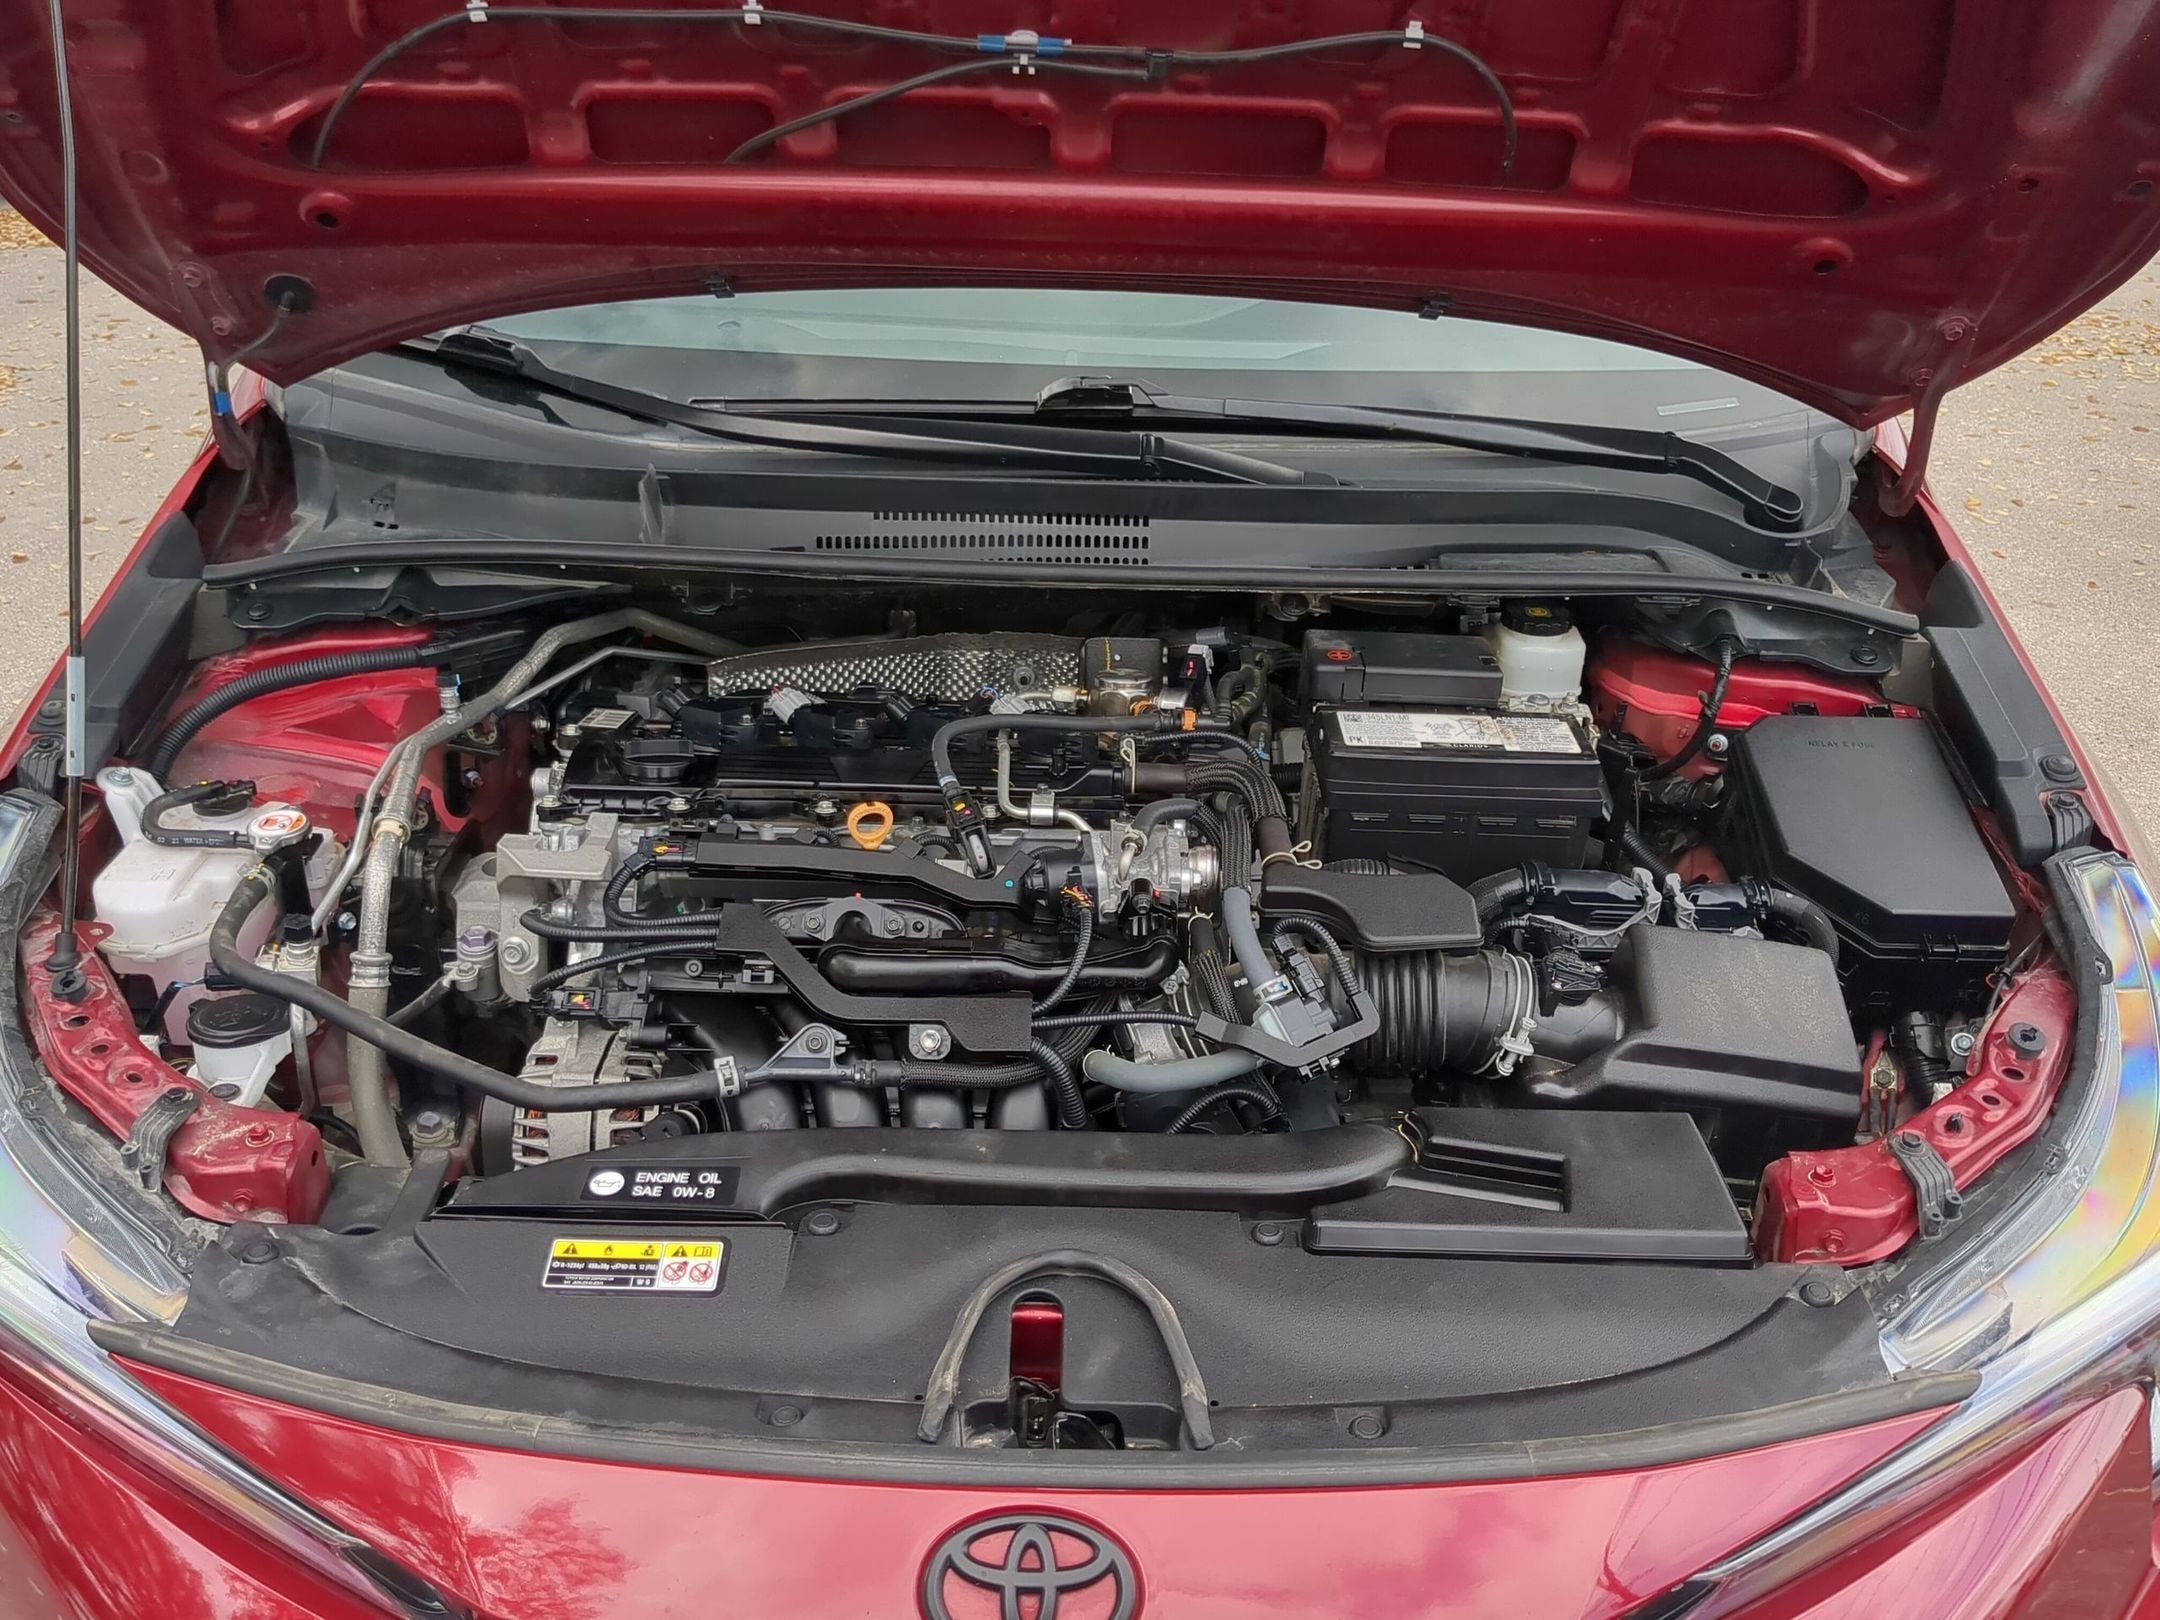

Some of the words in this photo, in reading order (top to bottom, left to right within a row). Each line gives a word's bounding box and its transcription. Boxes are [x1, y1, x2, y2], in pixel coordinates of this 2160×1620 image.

[635, 1172, 690, 1184] ENGINE
[698, 1172, 722, 1185] OIL
[632, 1185, 664, 1197] SAE
[672, 1186, 716, 1199] 0W-8
